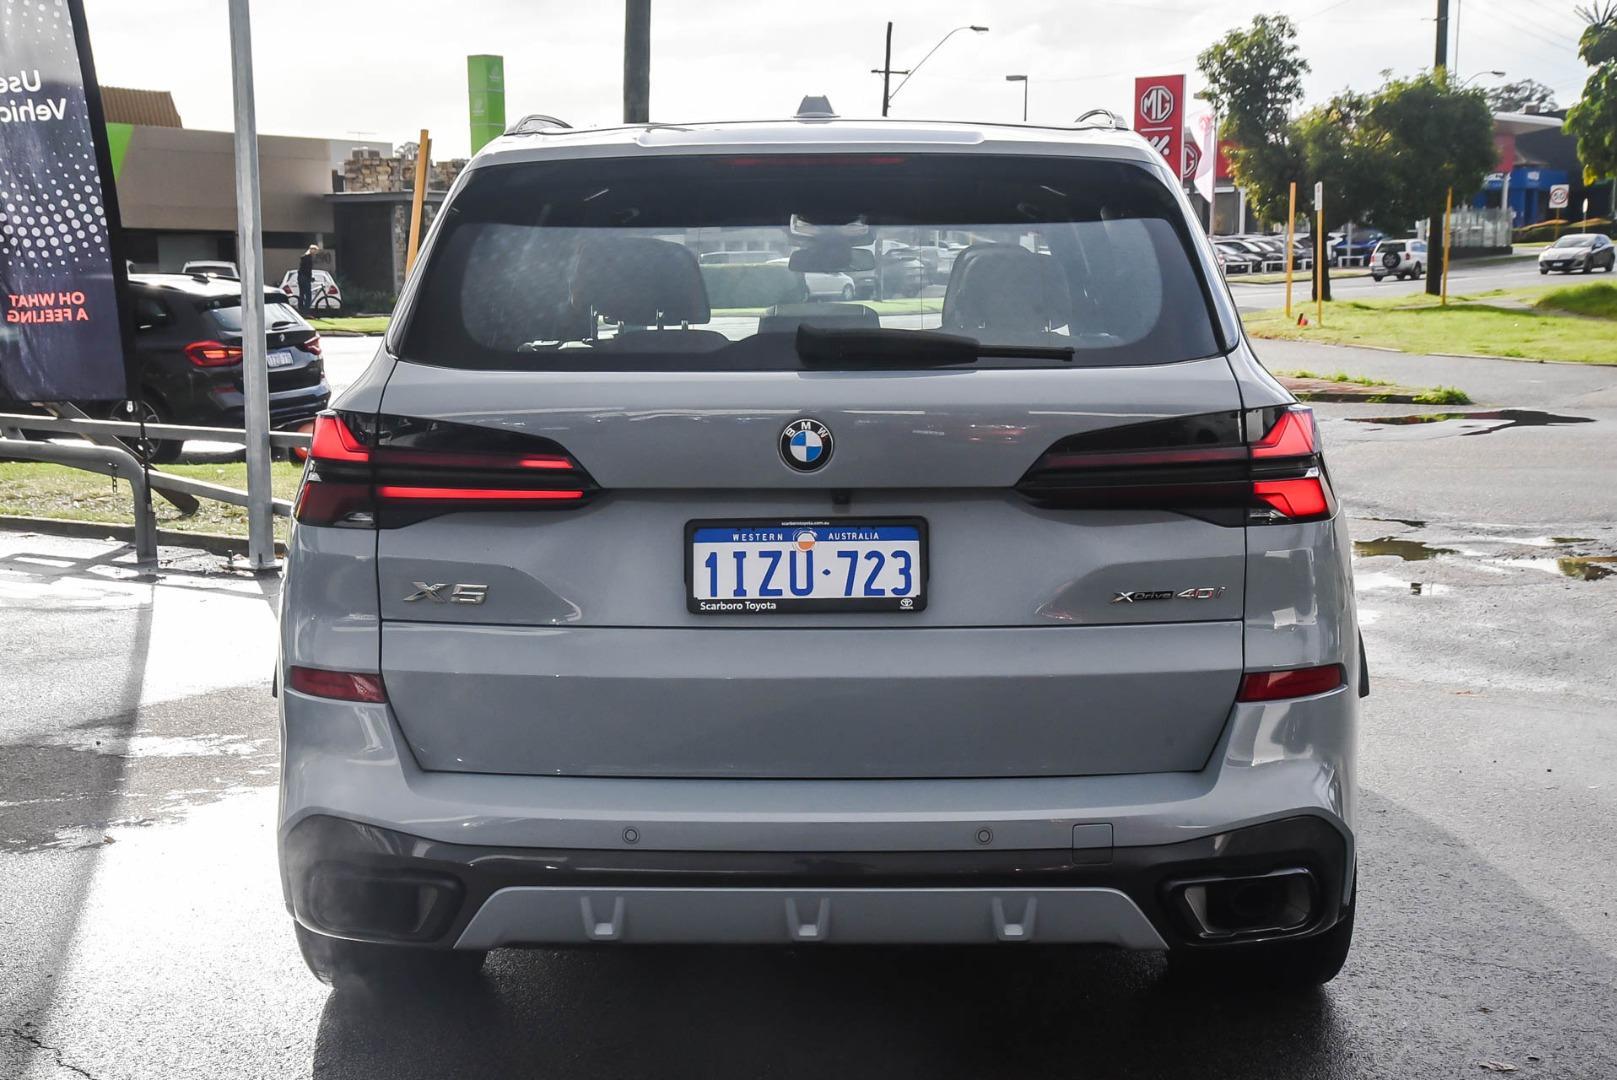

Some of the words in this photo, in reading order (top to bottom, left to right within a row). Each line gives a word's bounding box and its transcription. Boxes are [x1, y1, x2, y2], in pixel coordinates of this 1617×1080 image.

[1143, 88, 1171, 121] MG
[785, 421, 829, 438] BMW
[733, 533, 783, 541] WESTERN
[828, 532, 880, 540] AUSTRALIA
[403, 581, 488, 604] X5
[700, 602, 743, 610] Scarboro
[745, 601, 776, 611] Toyota
